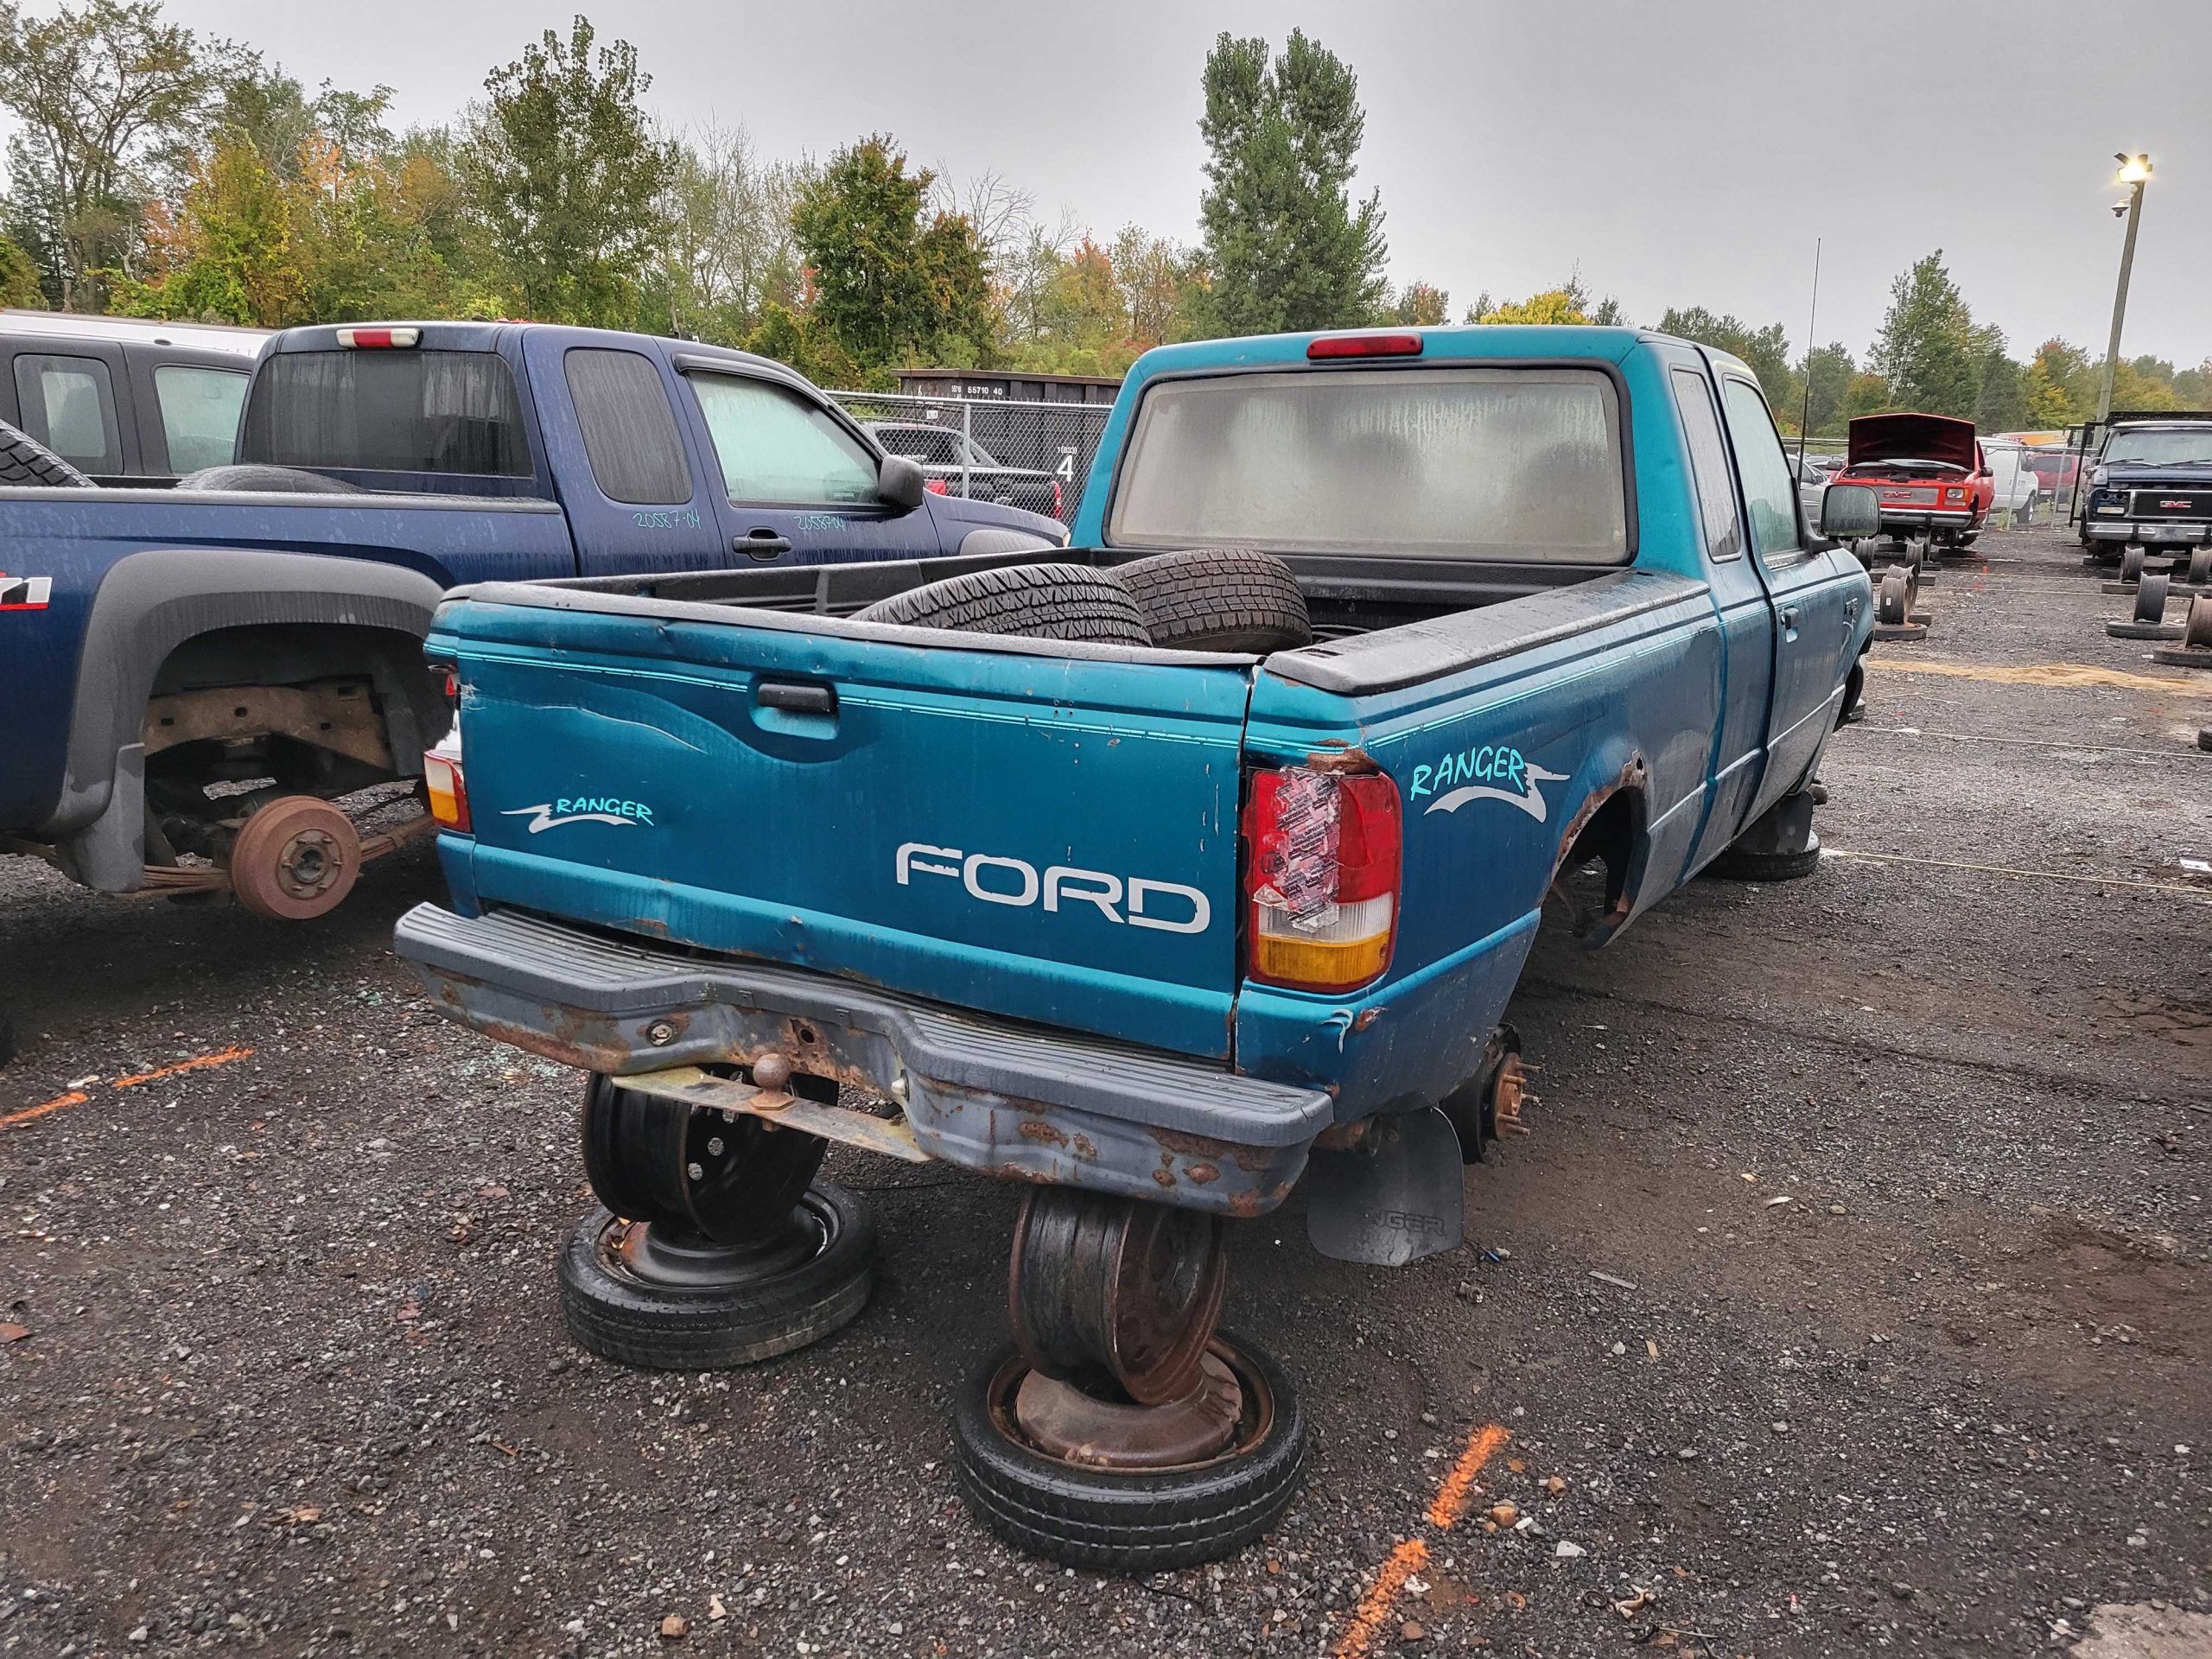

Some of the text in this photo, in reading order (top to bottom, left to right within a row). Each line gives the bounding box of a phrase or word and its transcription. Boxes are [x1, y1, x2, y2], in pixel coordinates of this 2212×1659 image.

[968, 386, 988, 395] 55710
[993, 387, 1003, 396] 40
[1057, 455, 1073, 482] 4
[1410, 746, 1525, 802] RANGER
[556, 797, 655, 827] RANGER
[896, 842, 1211, 934] FORD
[1372, 1210, 1446, 1236] NGER
